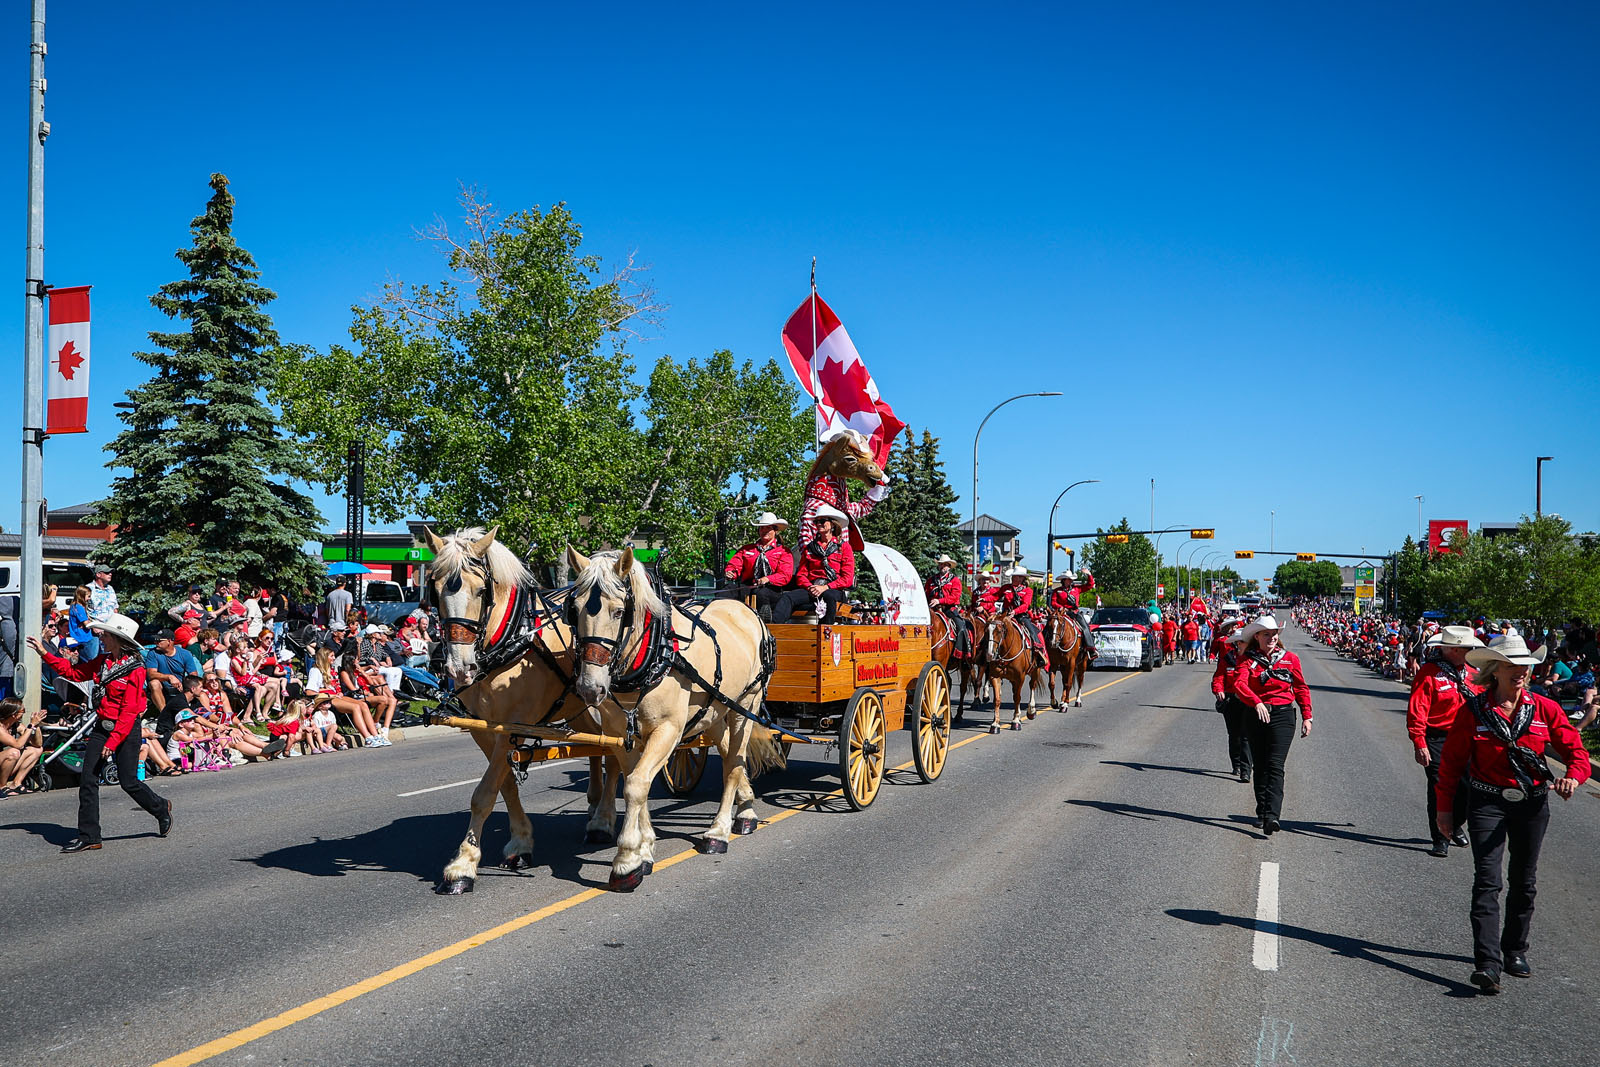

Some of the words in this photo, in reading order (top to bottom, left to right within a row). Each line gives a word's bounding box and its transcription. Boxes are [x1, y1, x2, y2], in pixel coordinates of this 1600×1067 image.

[410, 550, 420, 559] TD
[857, 664, 874, 681] Show
[874, 664, 883, 679] On
[883, 662, 898, 678] Earth
